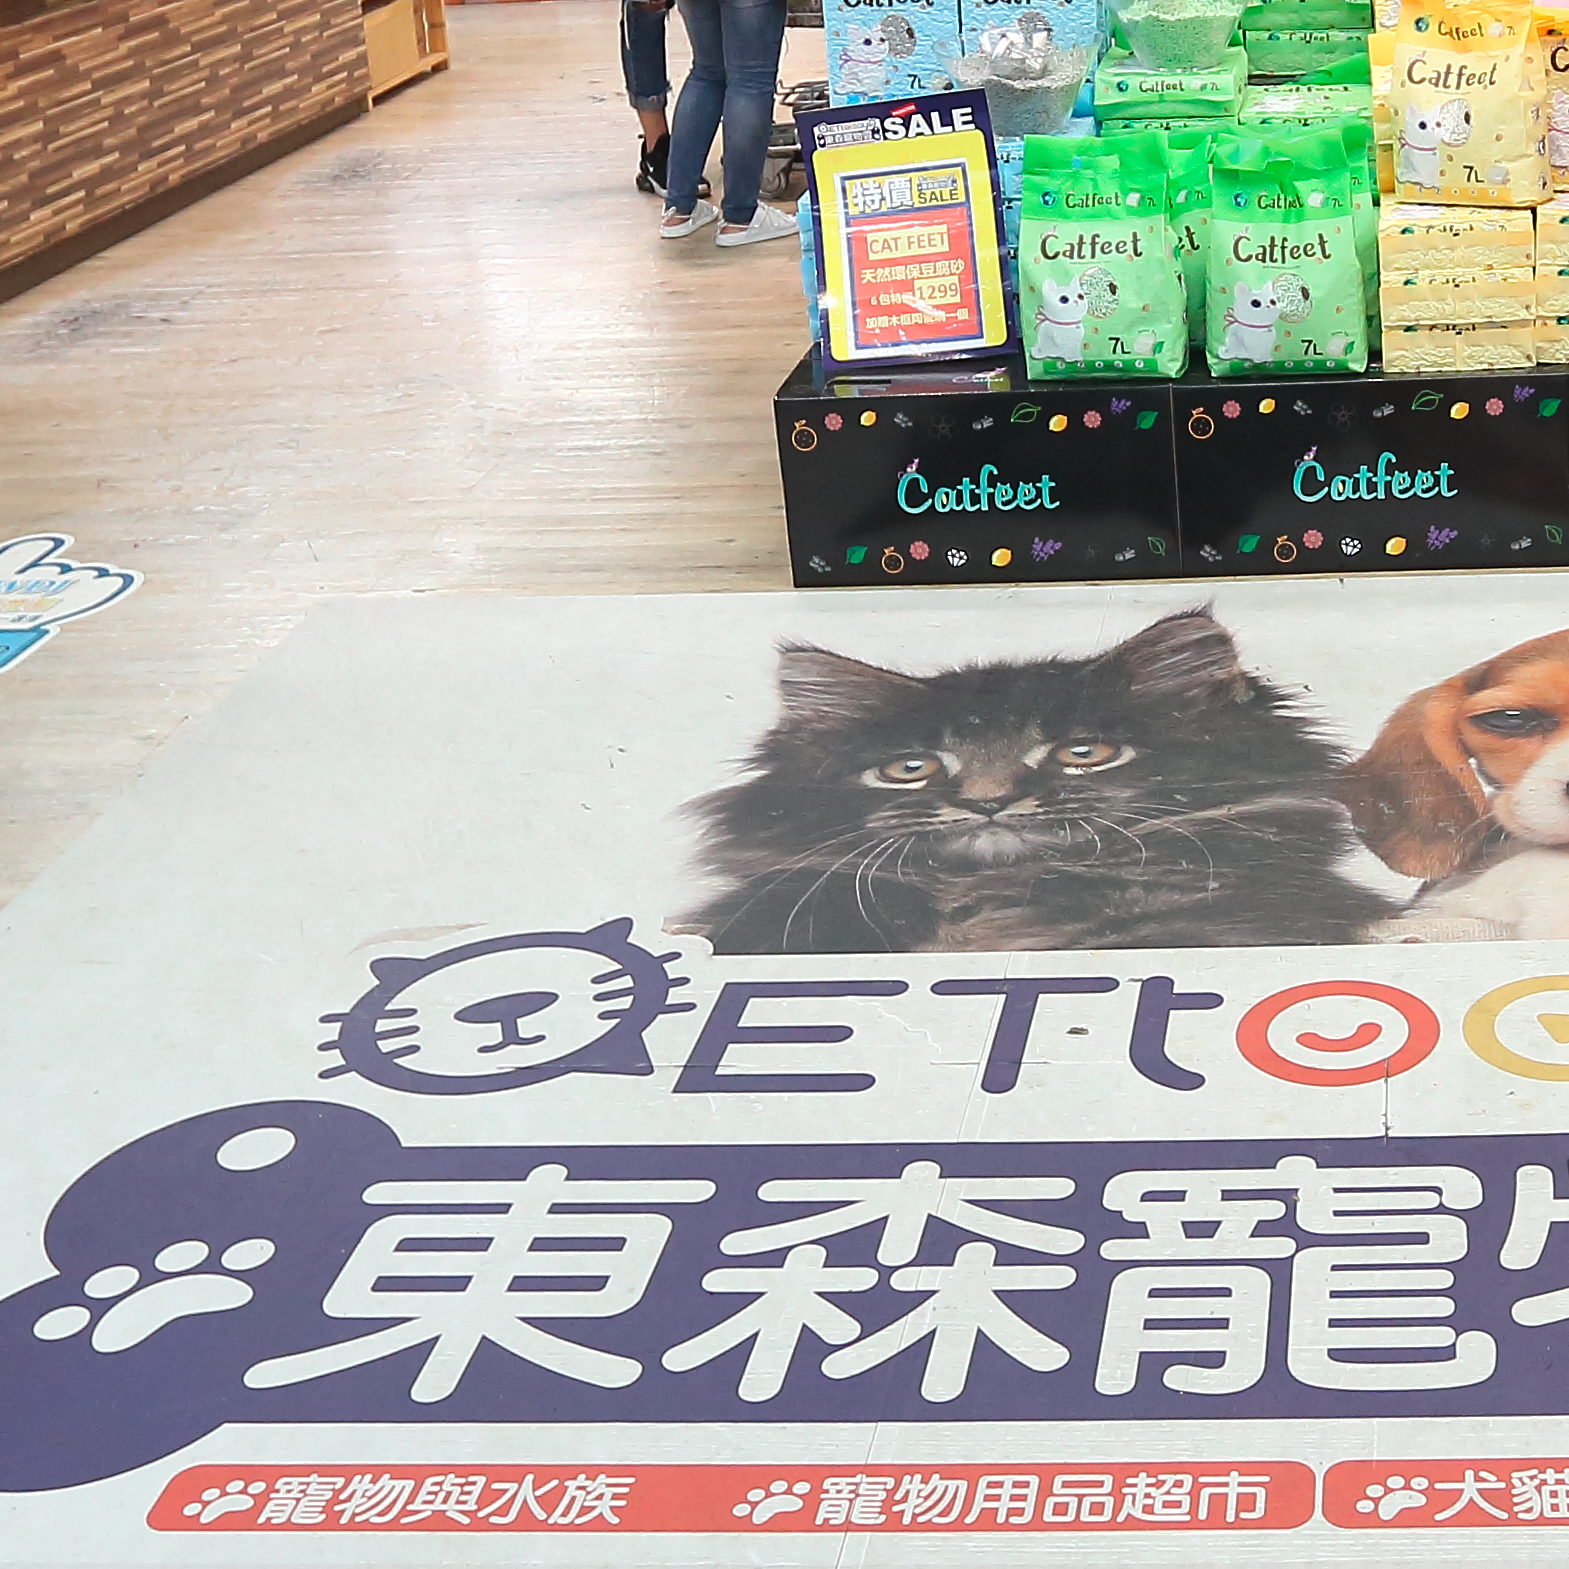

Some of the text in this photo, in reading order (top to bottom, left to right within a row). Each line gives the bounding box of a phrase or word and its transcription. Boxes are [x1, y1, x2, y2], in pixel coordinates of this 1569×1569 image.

[908, 73, 927, 90] 7L
[1405, 57, 1499, 90] Catfeet
[1138, 79, 1185, 93] Catfeet
[883, 106, 977, 140] SALE
[1462, 165, 1485, 185] 7L
[851, 175, 914, 212] 特價
[917, 188, 960, 205] SALE
[1064, 190, 1157, 210] Catfeet 7L
[868, 231, 948, 255] CAT FEET
[1038, 227, 1144, 261] Catfeet
[1232, 232, 1333, 263] Catfeet
[916, 282, 959, 301] 1299
[1109, 336, 1131, 357] 7L
[1300, 338, 1324, 358] 7L
[896, 462, 1061, 515] Catfeet
[1292, 449, 1459, 506] Catfeet
[259, 1470, 639, 1529] 寵物與水族
[813, 1469, 1272, 1528] 寵物用品超市
